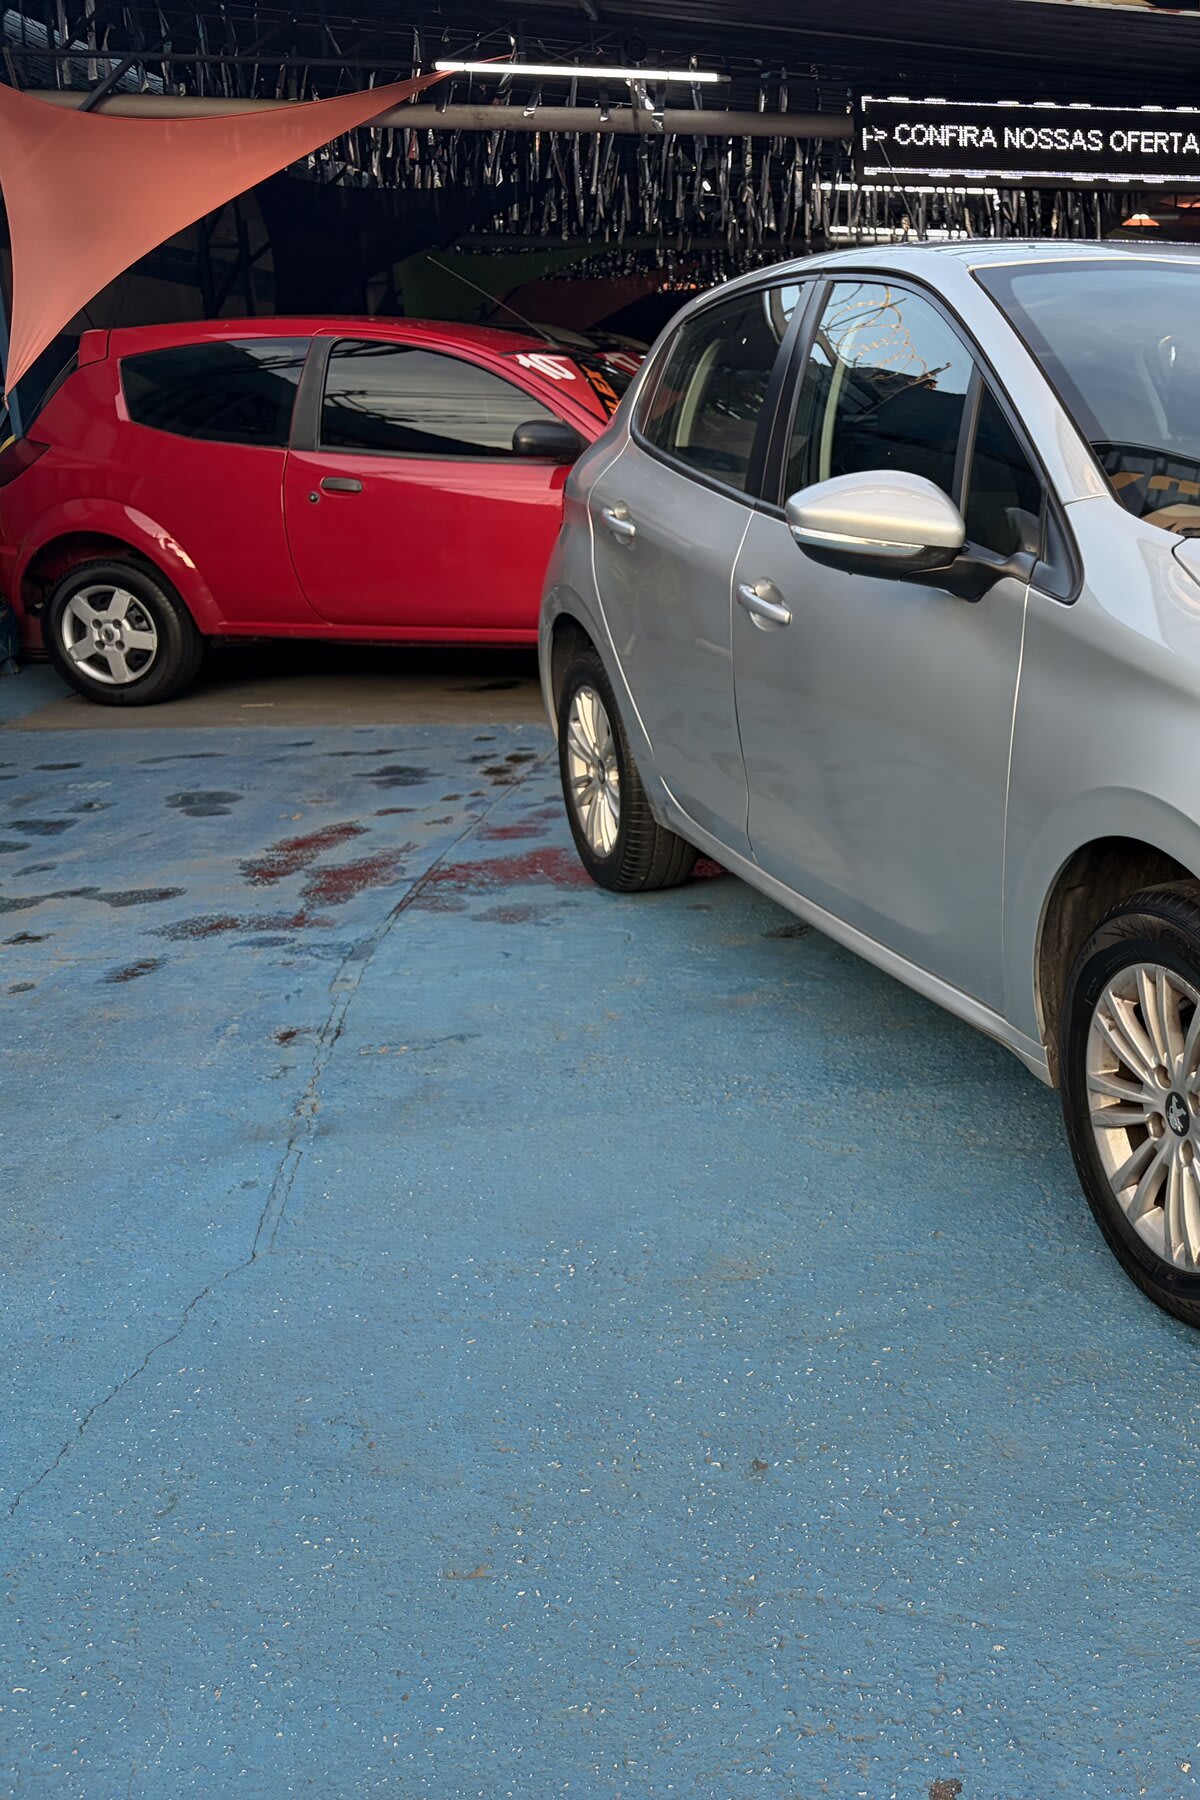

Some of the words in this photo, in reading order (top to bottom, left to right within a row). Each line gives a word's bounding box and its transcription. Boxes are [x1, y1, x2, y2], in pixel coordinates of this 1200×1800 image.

[894, 124, 997, 148] CONFIRA
[1004, 127, 1103, 152] NOSSAS
[516, 353, 576, 380] 10
